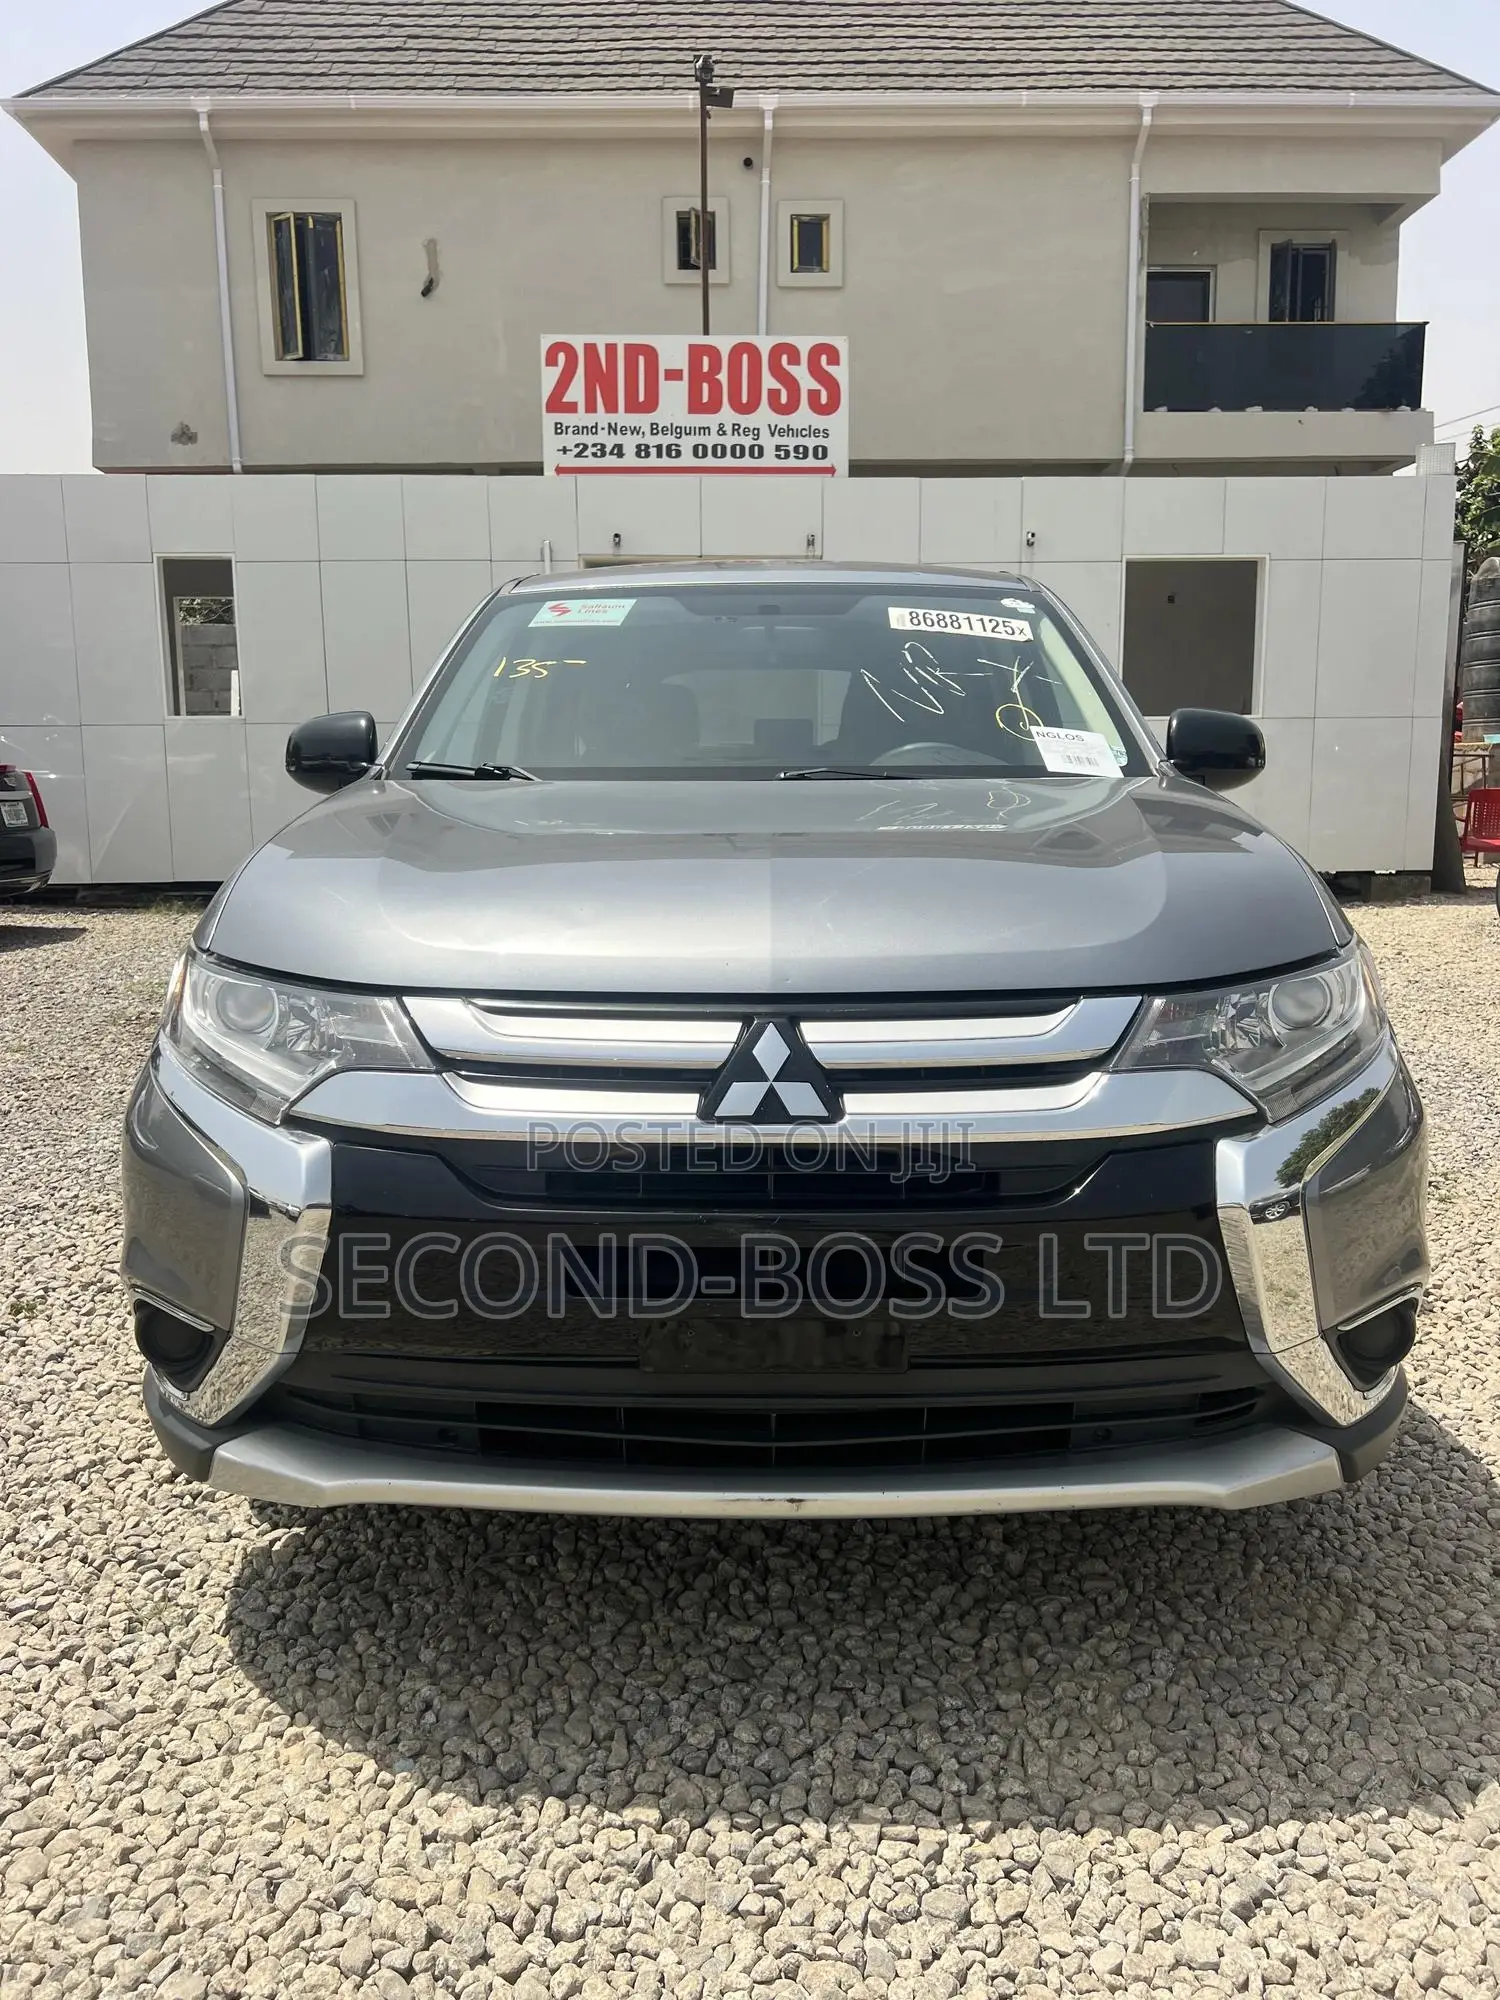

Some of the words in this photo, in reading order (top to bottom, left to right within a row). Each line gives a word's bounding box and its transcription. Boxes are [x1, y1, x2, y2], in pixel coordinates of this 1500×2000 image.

[545, 341, 841, 416] 2ND-BOSS
[650, 423, 711, 439] Belguim
[716, 422, 728, 437] &
[732, 423, 760, 440] Reg
[768, 424, 830, 439] Vehicles
[556, 442, 625, 459] +234
[635, 443, 682, 459] 816
[692, 443, 764, 460] 0000
[774, 444, 829, 460] 590
[1035, 731, 1085, 742] NGLOS
